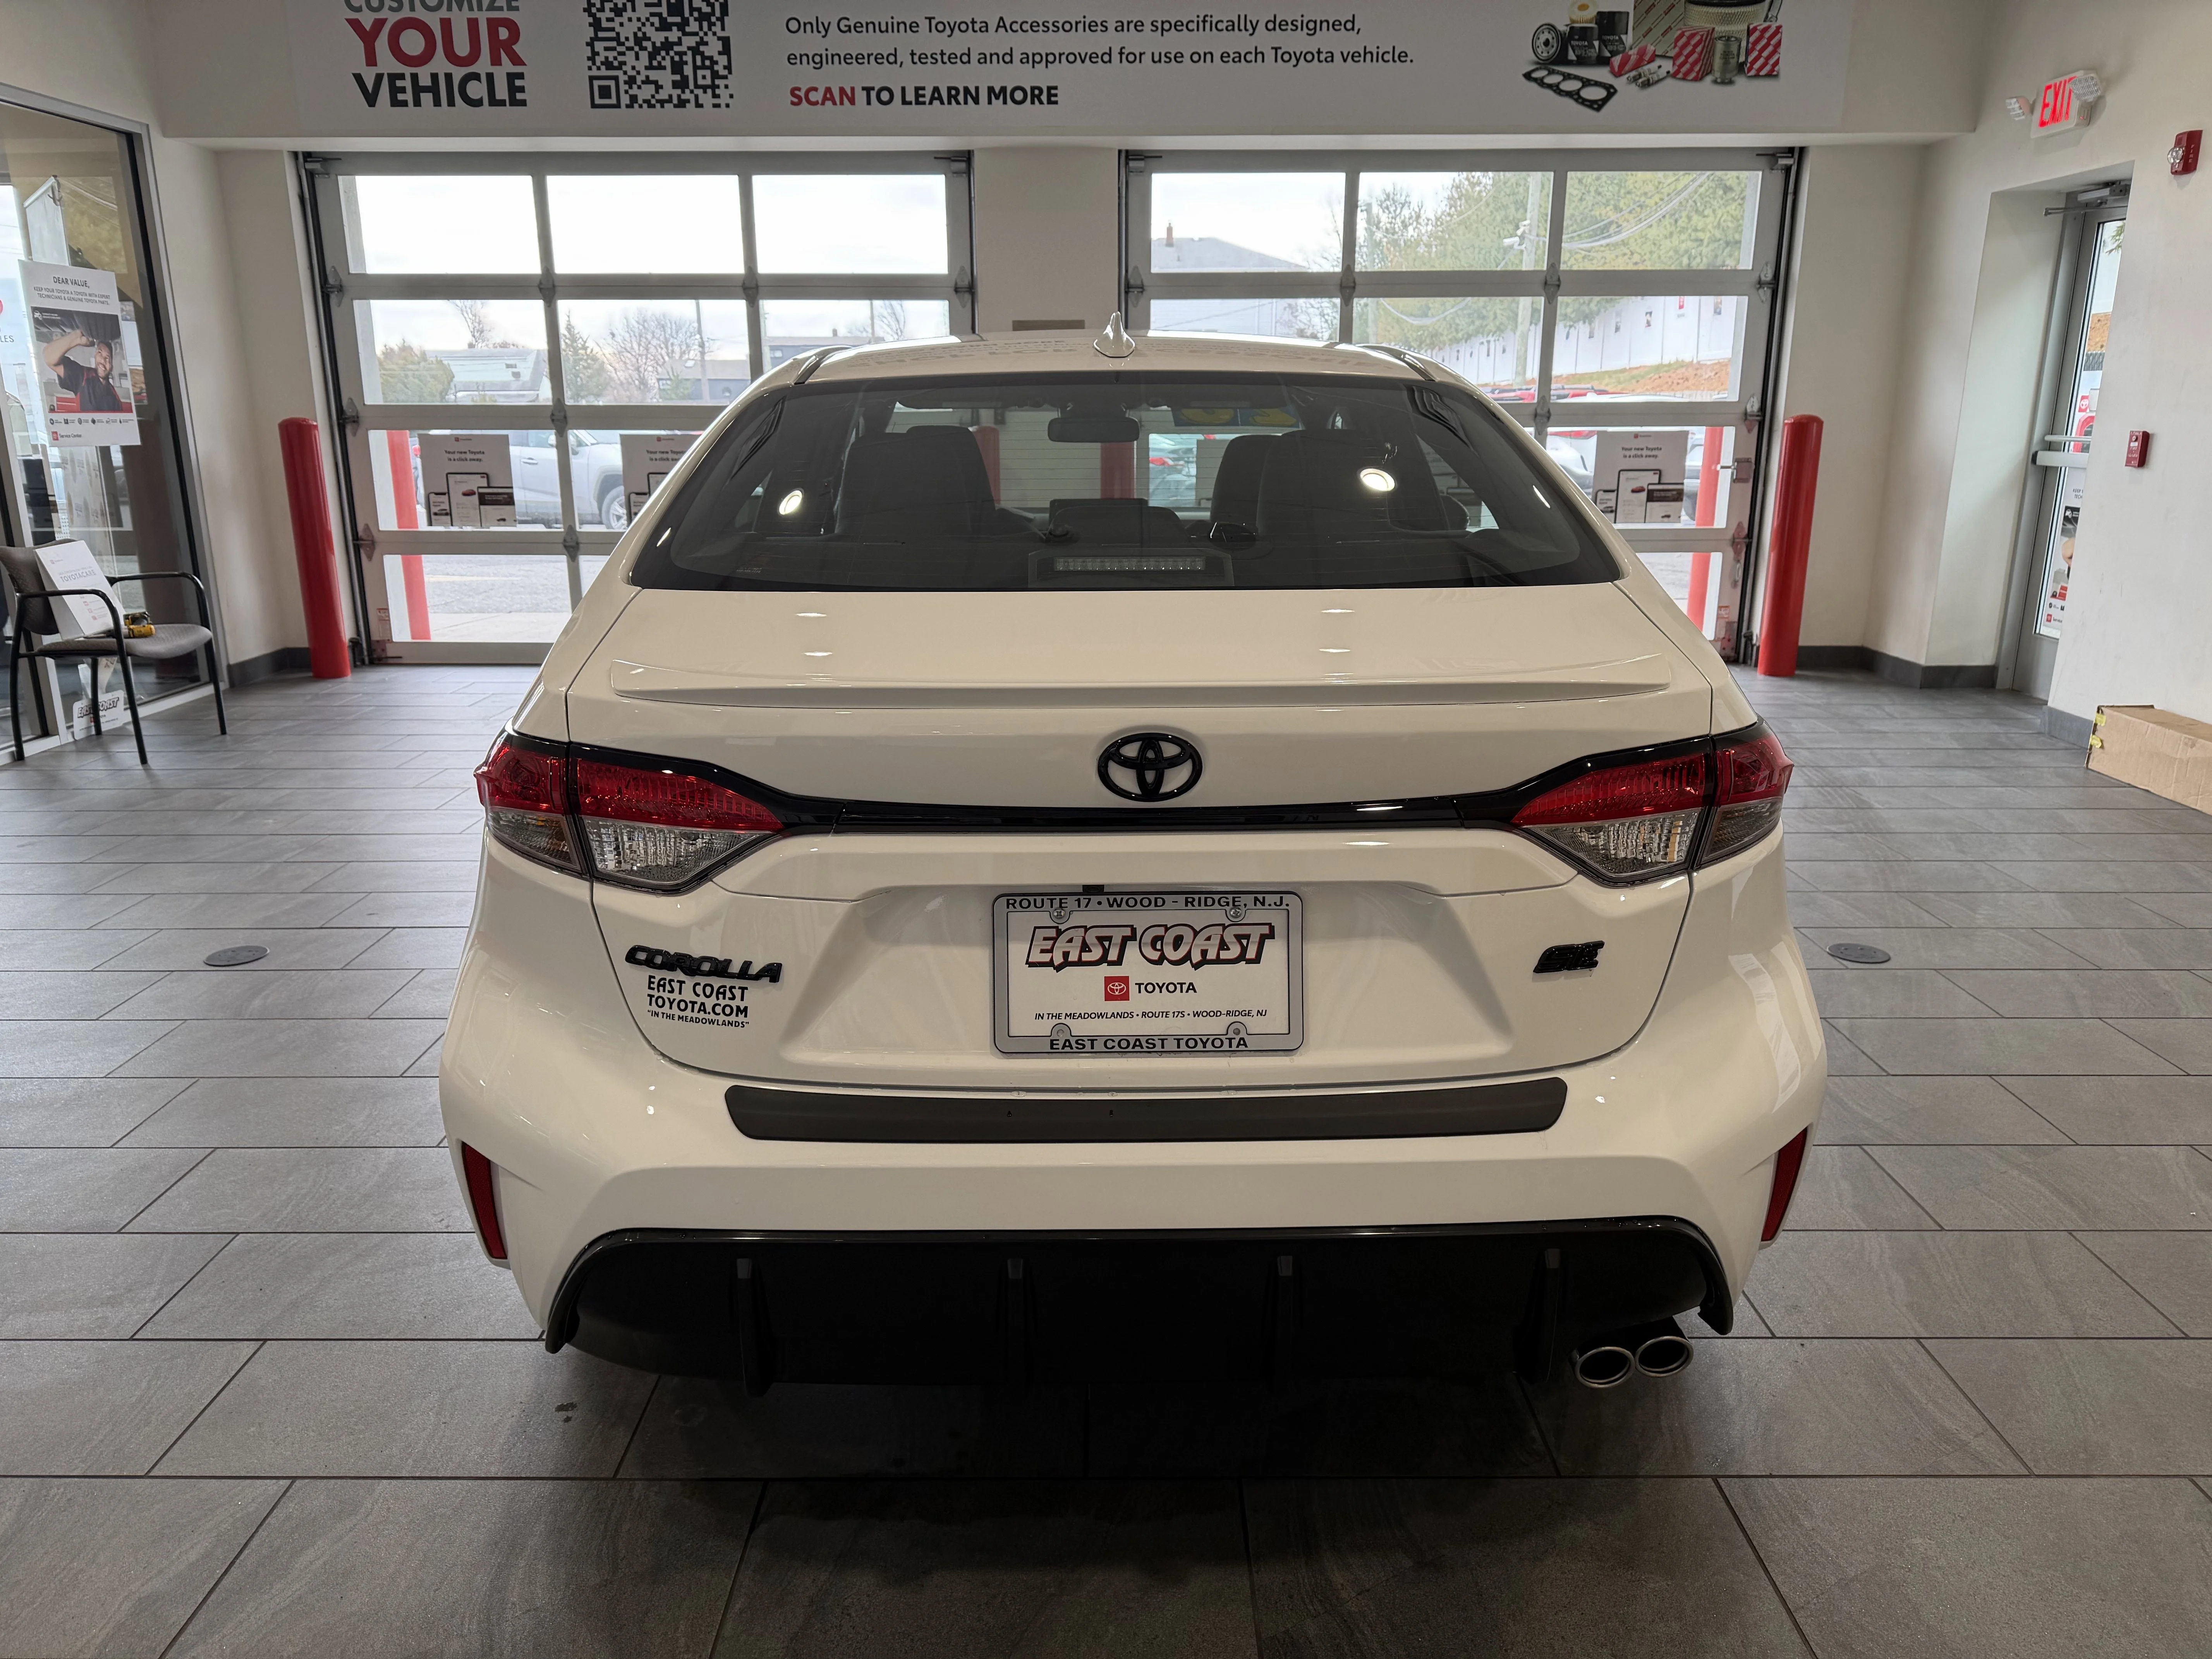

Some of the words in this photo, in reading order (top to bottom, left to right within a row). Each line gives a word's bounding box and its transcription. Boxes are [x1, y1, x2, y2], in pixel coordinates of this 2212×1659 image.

[785, 17, 831, 38] Only
[837, 17, 919, 34] Genuine
[925, 16, 989, 37] Toyota
[995, 15, 1108, 33] Accessories
[1114, 18, 1144, 32] are
[1151, 14, 1259, 36] specifically
[1265, 14, 1361, 36] designed,
[344, 17, 527, 67] YOUR
[787, 48, 903, 70] engineered,
[910, 47, 970, 65] tested
[977, 47, 1013, 64] and
[1020, 47, 1112, 68] approved
[1118, 46, 1146, 64] for
[1151, 50, 1184, 64] use
[1190, 49, 1214, 64] on
[1220, 46, 1265, 63] each
[1271, 46, 1334, 67] Toyota
[1341, 46, 1413, 63] vehicle.
[352, 72, 527, 107] VEHICLE
[790, 86, 855, 106] SCAN
[862, 86, 894, 106] TO
[901, 86, 979, 105] LEARN
[987, 86, 1058, 105] MORE
[2039, 76, 2077, 128] EXIT
[53, 276, 69, 285] DEAR
[70, 278, 89, 289] VALUE,
[60, 569, 96, 582] TOYOTACARE
[99, 697, 119, 711] OAST
[1006, 898, 1068, 909] ROUTE
[1074, 898, 1092, 908] 17
[1106, 897, 1166, 908] WOOD
[1184, 896, 1247, 908] RIDGE,
[1254, 896, 1290, 907] N.J.
[1025, 925, 1137, 972] EAST
[1139, 922, 1275, 971] COAST
[625, 945, 782, 983] COROLLA
[647, 975, 686, 995] EAST
[692, 982, 749, 1001] COAST
[1135, 982, 1197, 994] TOYOTA
[647, 994, 749, 1018] TOYOTA.COM
[661, 1012, 675, 1020] THE
[1064, 1011, 1134, 1020] MEADOWLANDS
[1141, 1011, 1170, 1019] ROUTE
[1172, 1010, 1185, 1018] 17S
[1193, 1010, 1254, 1018] WOOD-RIDGE,
[1049, 1038, 1099, 1051] EAST
[1103, 1037, 1168, 1050] COAST
[1173, 1037, 1249, 1050] TOYOTA
